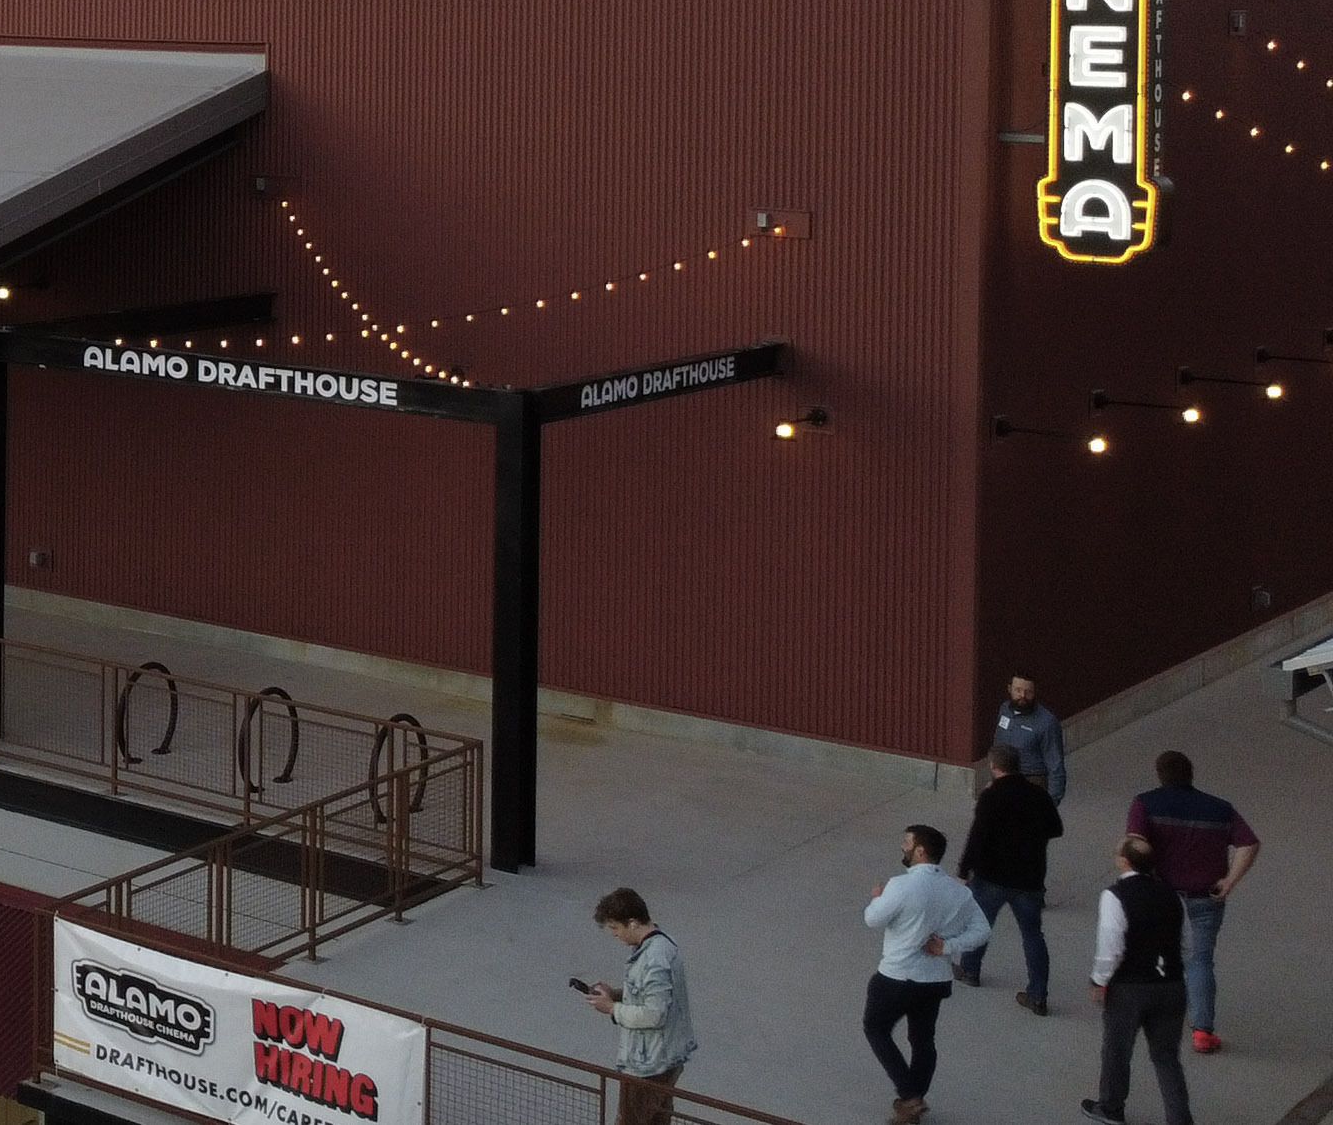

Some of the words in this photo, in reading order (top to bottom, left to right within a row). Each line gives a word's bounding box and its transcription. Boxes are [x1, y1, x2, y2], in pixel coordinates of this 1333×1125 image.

[83, 346, 188, 380] ALAMO
[197, 360, 398, 406] DRAFTHOUSE
[581, 380, 638, 408] ALAMO
[642, 356, 736, 399] DRAFTHOUSE
[85, 969, 201, 1030] ALAMO
[89, 999, 155, 1030] DRAFTHOUSE
[156, 1021, 196, 1044] CINEMA
[251, 998, 345, 1062] NOW
[253, 1041, 379, 1122] HIRING
